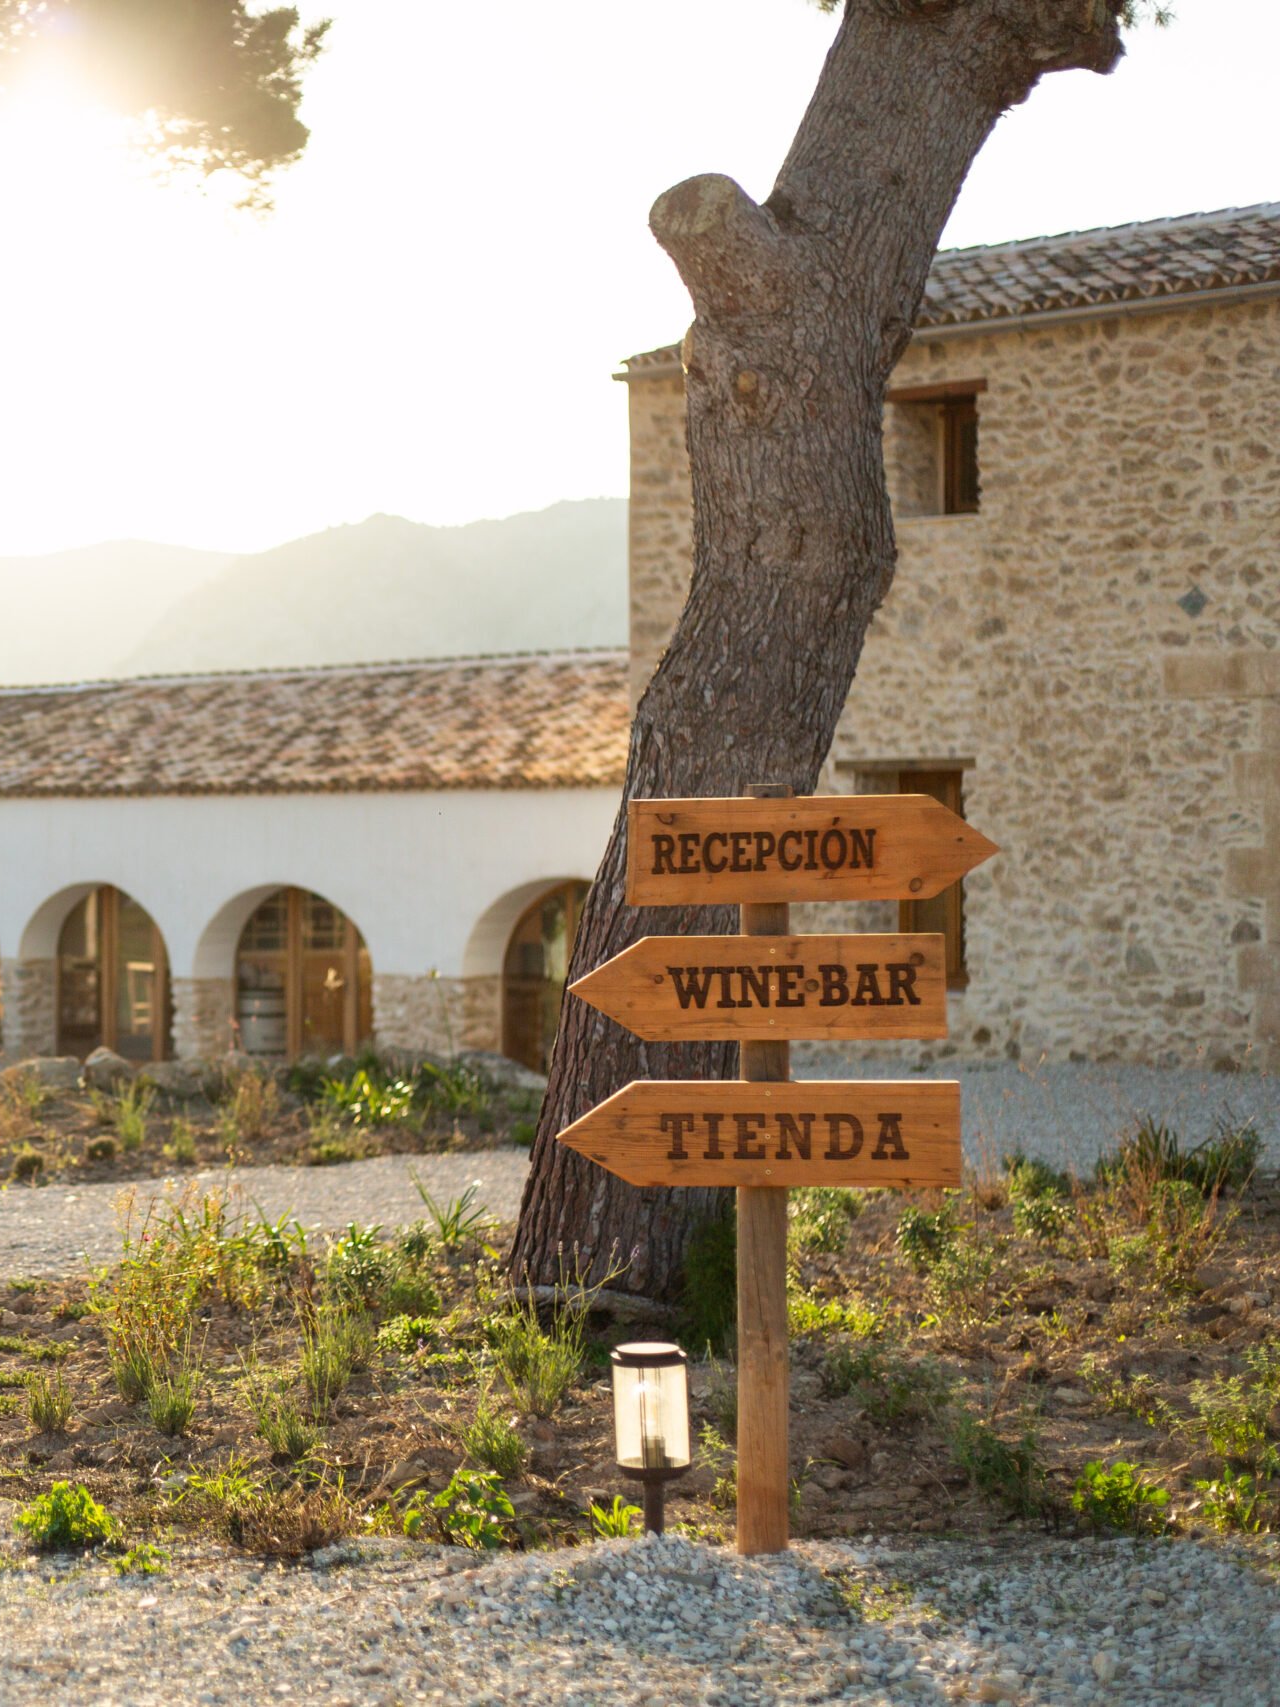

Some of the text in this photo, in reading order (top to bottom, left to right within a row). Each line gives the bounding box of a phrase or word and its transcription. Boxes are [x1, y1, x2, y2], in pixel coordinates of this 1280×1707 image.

[652, 816, 875, 873] RECEPCIÓN
[668, 963, 921, 1009] WINE BAR
[661, 1113, 908, 1160] TIENDA
